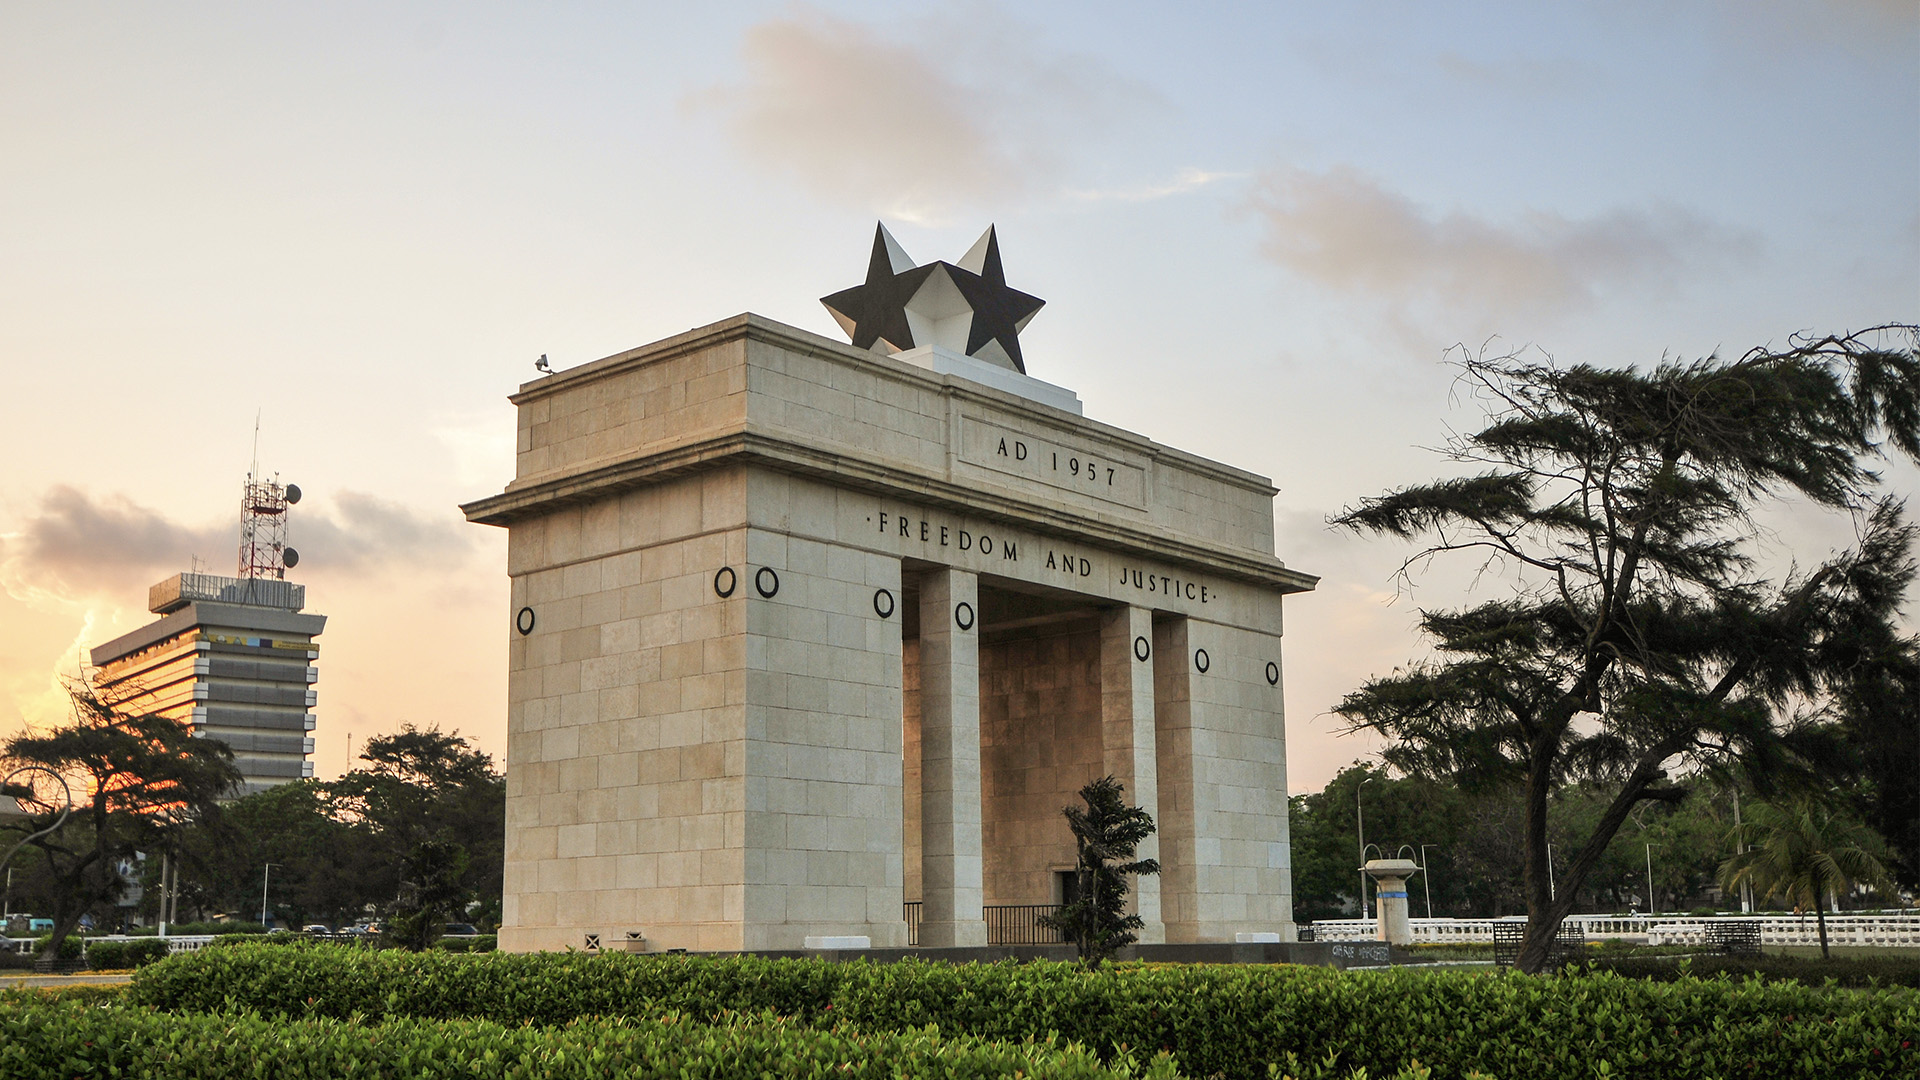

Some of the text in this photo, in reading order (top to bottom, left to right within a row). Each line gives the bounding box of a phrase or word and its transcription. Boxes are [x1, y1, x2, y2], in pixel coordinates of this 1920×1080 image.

[997, 437, 1115, 486] AD 1957
[1046, 550, 1091, 577] AND
